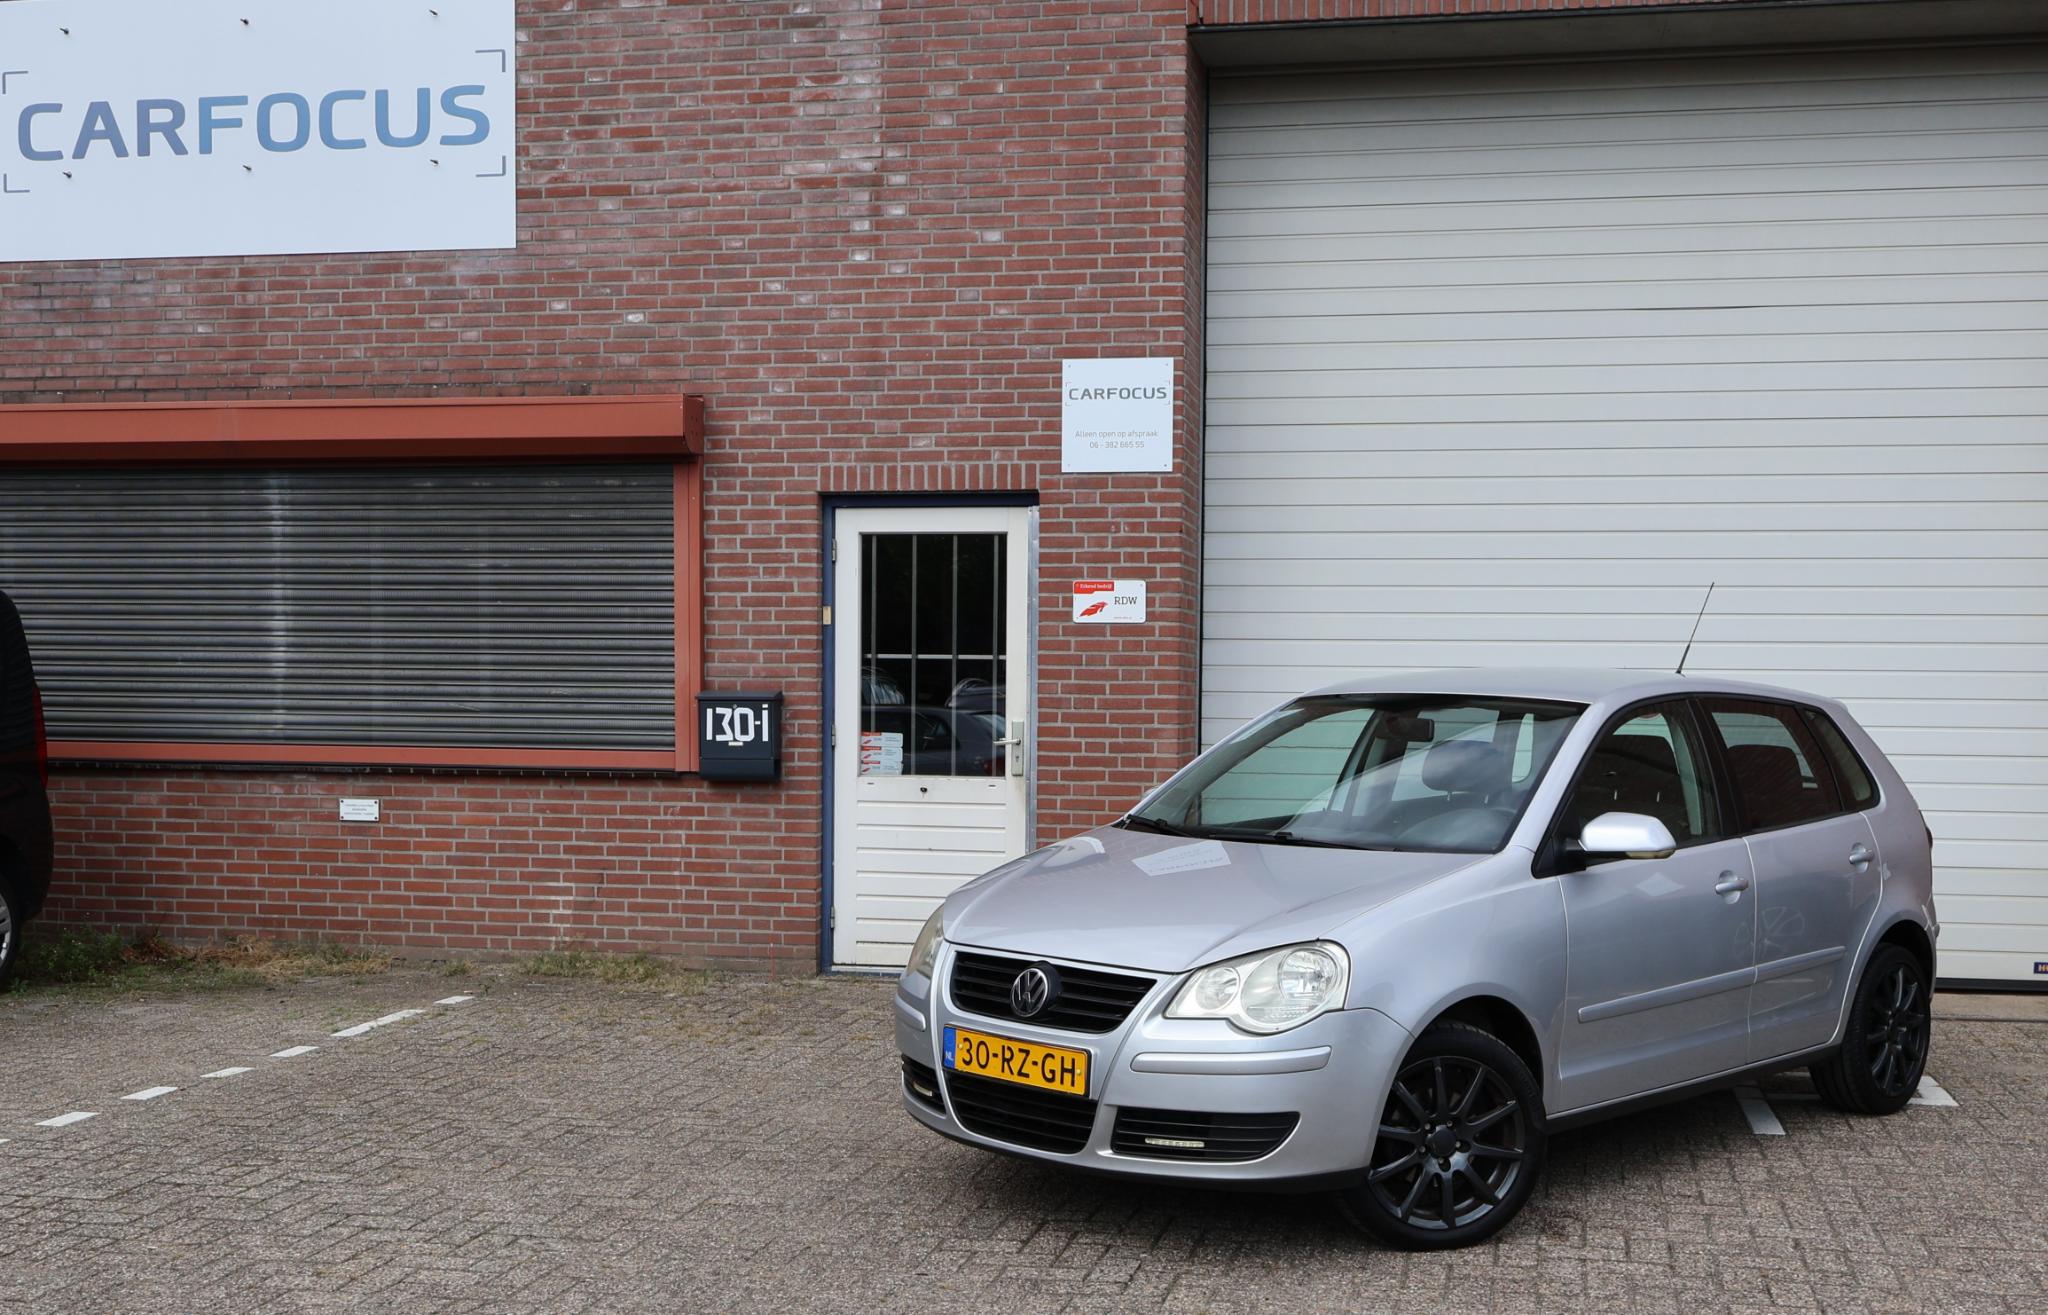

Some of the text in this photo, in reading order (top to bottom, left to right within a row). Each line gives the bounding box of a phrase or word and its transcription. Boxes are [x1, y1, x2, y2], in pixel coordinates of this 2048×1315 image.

[17, 84, 491, 161] CARFOCUS
[1069, 387, 1167, 400] CARFOCUS
[1075, 430, 1158, 439] Alleen open op afspraak
[1114, 596, 1138, 605] RDW
[945, 1050, 954, 1061] NL
[962, 1037, 1076, 1087] 30-RZ-GH
